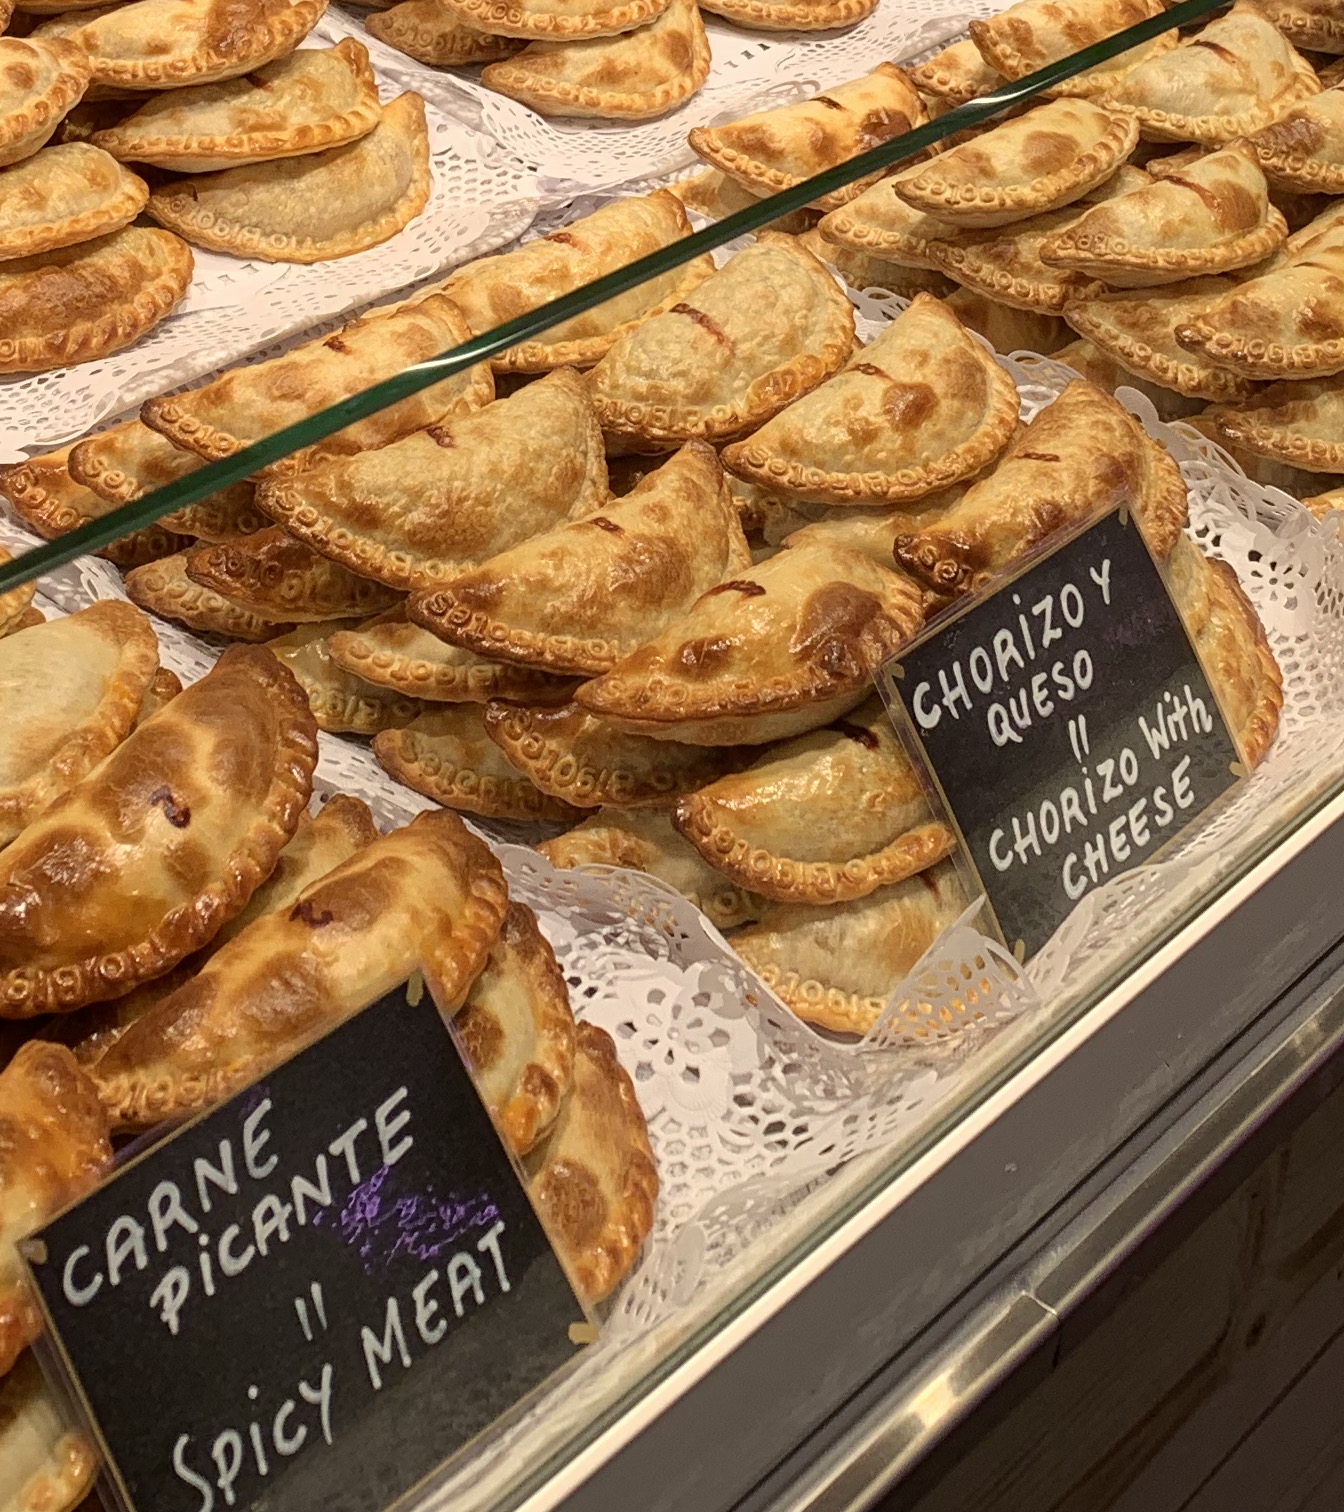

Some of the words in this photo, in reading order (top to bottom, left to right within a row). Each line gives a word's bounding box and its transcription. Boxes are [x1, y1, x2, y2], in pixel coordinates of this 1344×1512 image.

[1089, 559, 1112, 605] Y
[986, 649, 1094, 747] QUESO
[1061, 755, 1196, 901] CHEESE
[62, 1097, 280, 1308] CARNE
[359, 1220, 512, 1391] MEAT
